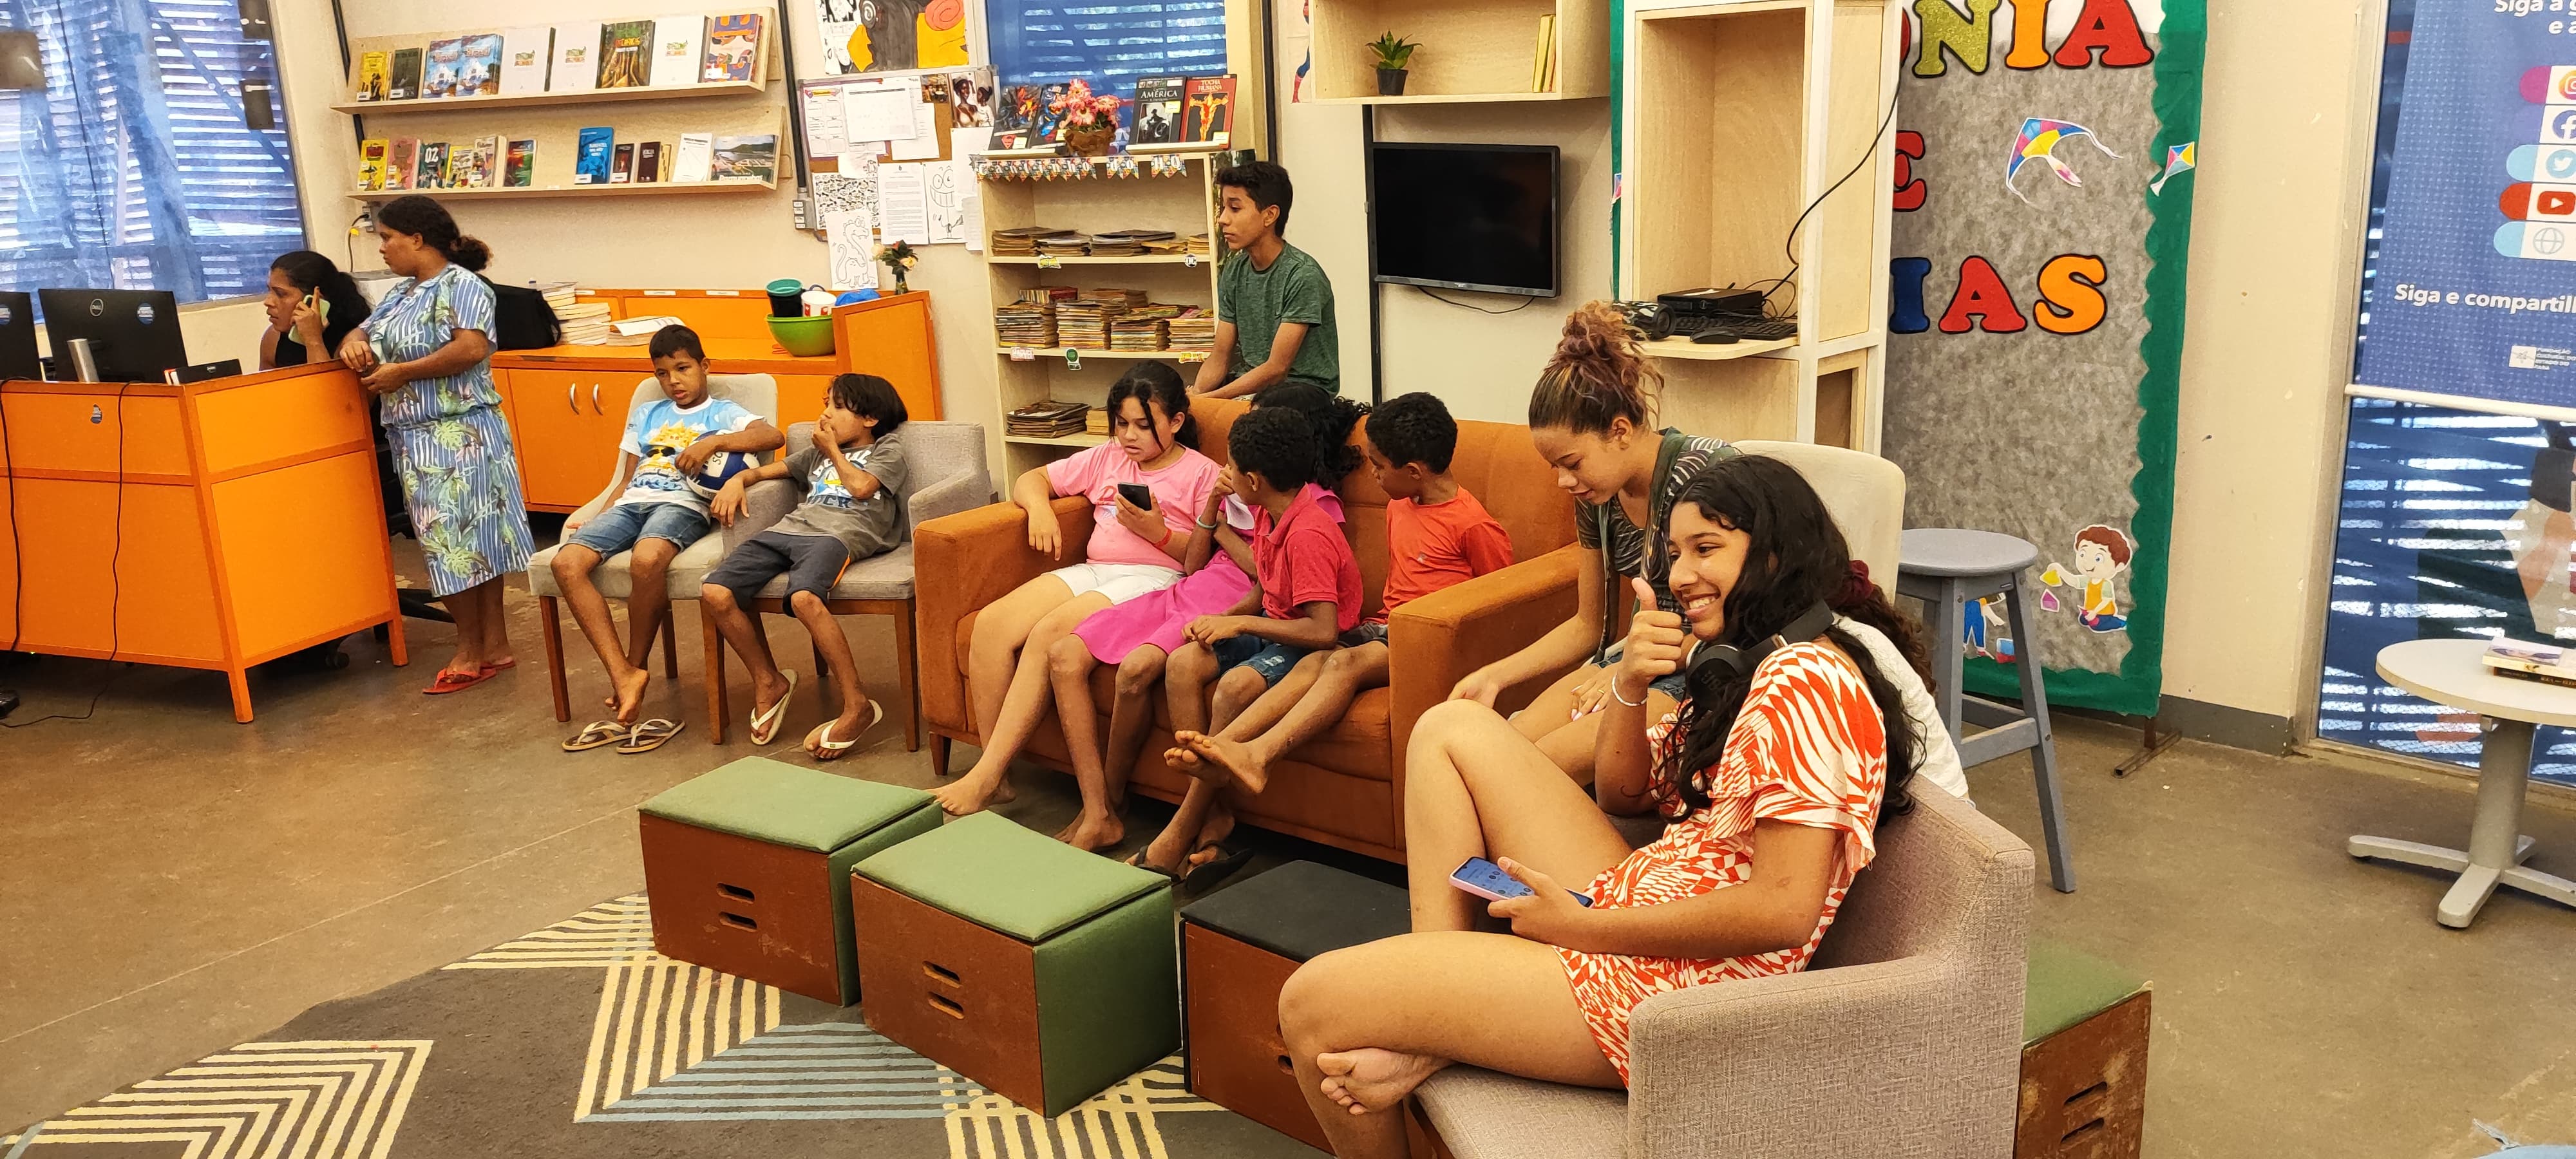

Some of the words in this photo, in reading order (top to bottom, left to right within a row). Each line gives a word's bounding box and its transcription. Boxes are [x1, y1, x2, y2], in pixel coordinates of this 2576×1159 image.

[2494, 0, 2543, 17] Siga
[2549, 0, 2563, 11] a
[1900, 0, 2154, 77] NIA
[2548, 21, 2563, 34] e
[1889, 253, 2107, 335] IAS
[2394, 283, 2441, 306] Siga
[2446, 291, 2459, 305] e
